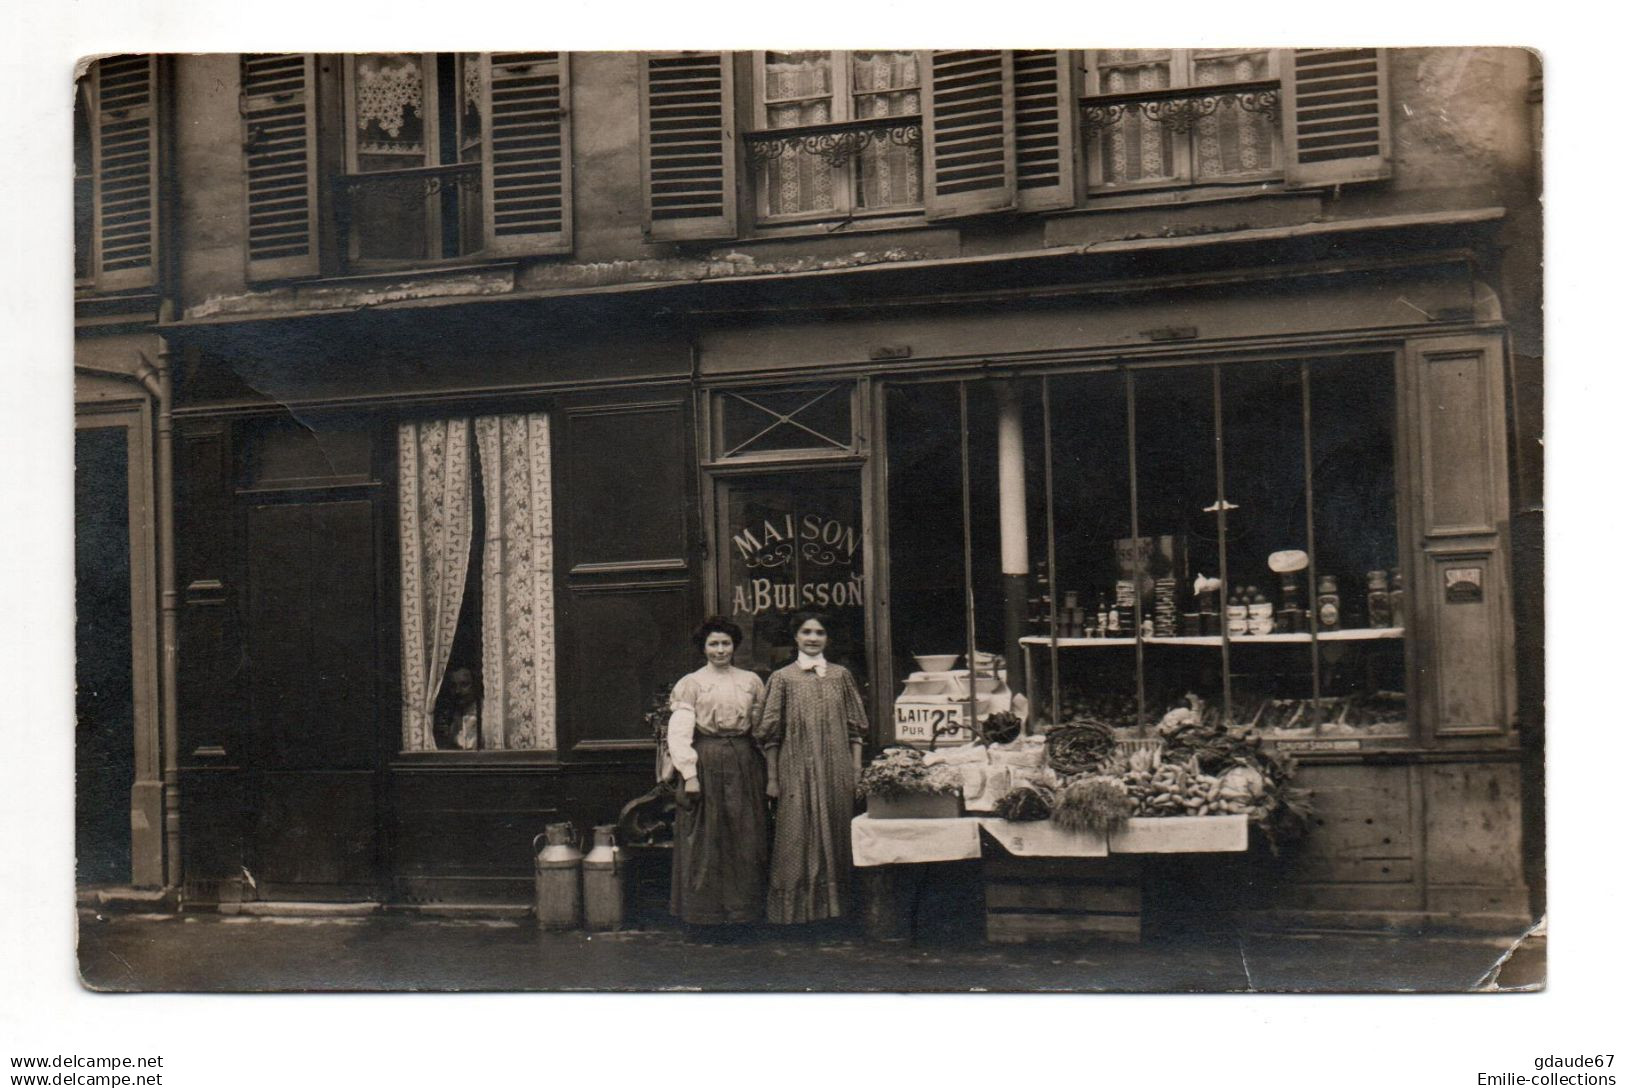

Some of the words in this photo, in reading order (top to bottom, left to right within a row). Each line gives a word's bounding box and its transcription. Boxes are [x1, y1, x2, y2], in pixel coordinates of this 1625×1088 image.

[733, 514, 862, 558] MAISON
[752, 573, 863, 615] BUISSON
[897, 707, 929, 722] LAIT
[931, 709, 959, 735] 25
[902, 726, 925, 735] PUR
